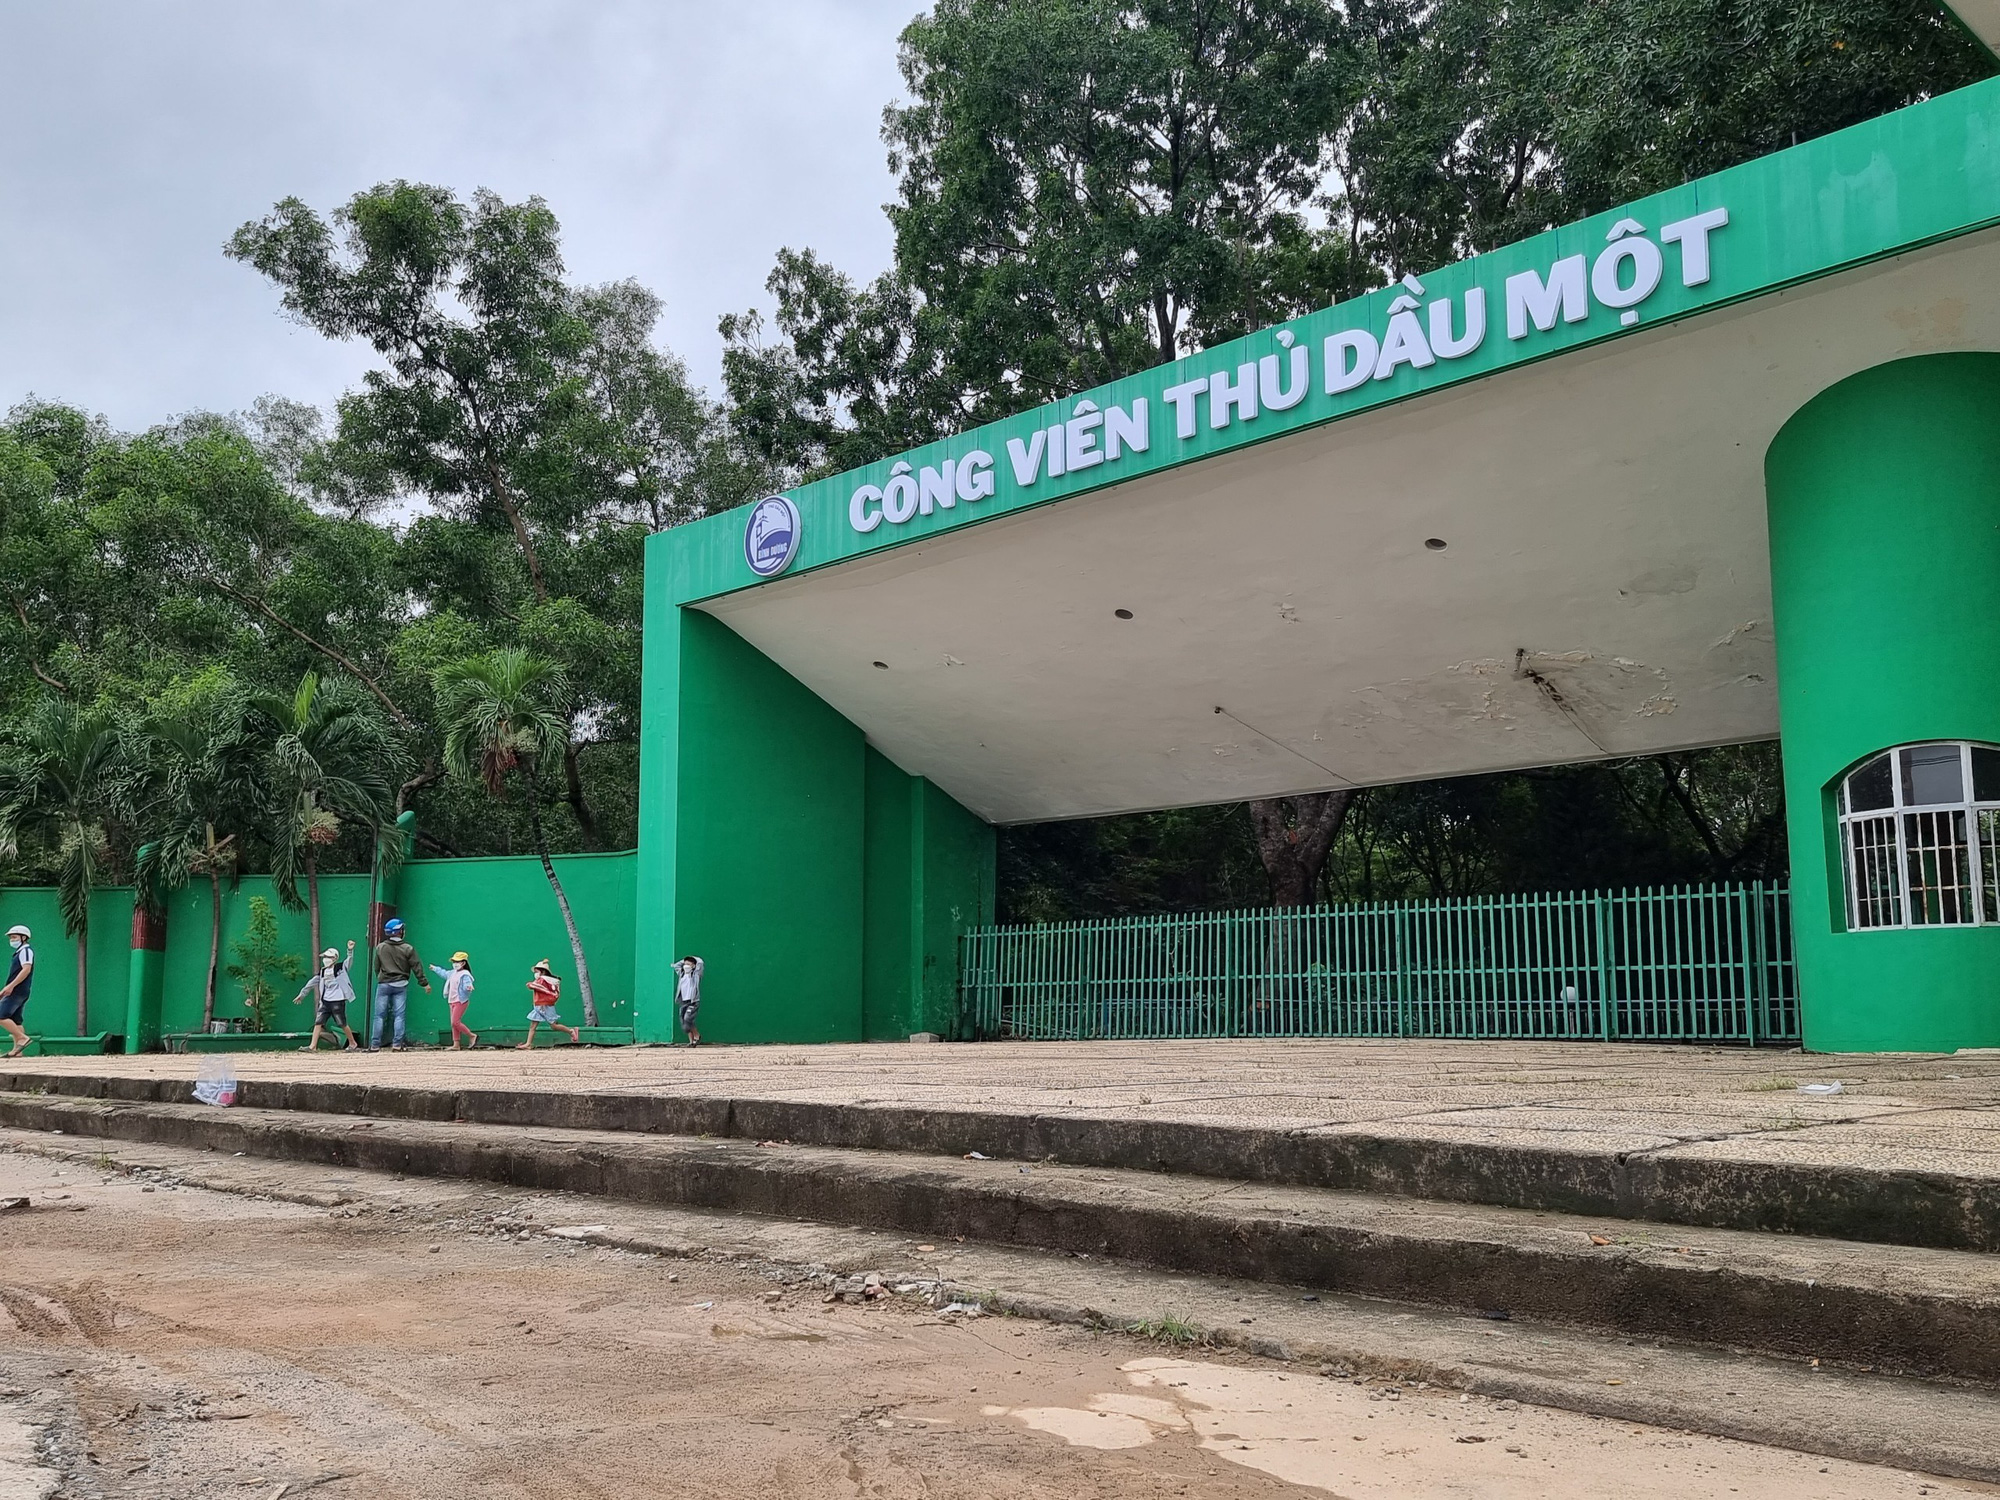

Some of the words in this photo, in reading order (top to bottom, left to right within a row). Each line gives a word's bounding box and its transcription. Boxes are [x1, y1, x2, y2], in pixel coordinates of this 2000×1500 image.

[849, 449, 995, 533] CÔNG
[1006, 397, 1149, 487] VIÊN
[1163, 330, 1310, 440] THỦ
[1323, 272, 1488, 395] DẦU
[1505, 207, 1730, 341] MỘT
